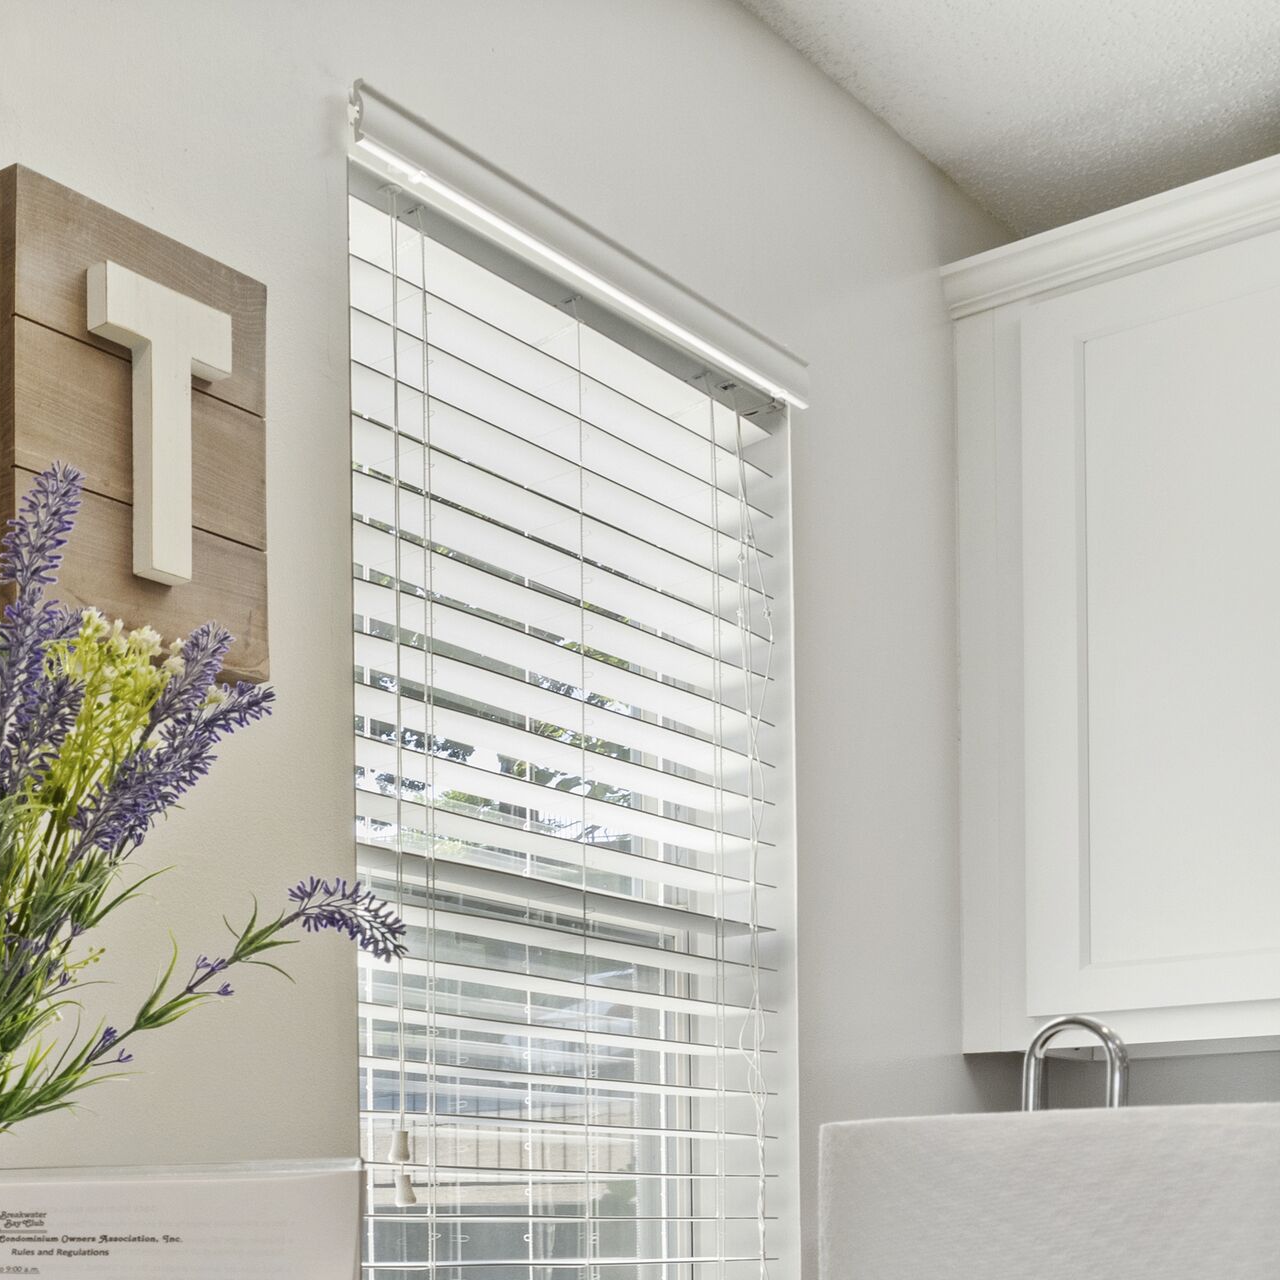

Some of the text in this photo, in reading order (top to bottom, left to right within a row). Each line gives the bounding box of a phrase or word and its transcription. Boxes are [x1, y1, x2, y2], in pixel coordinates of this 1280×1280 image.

[3, 1217, 44, 1228] Bay Club
[60, 1234, 96, 1243] Owners
[10, 1247, 109, 1257] Rules and Regulations
[4, 1265, 23, 1274] 9:00
